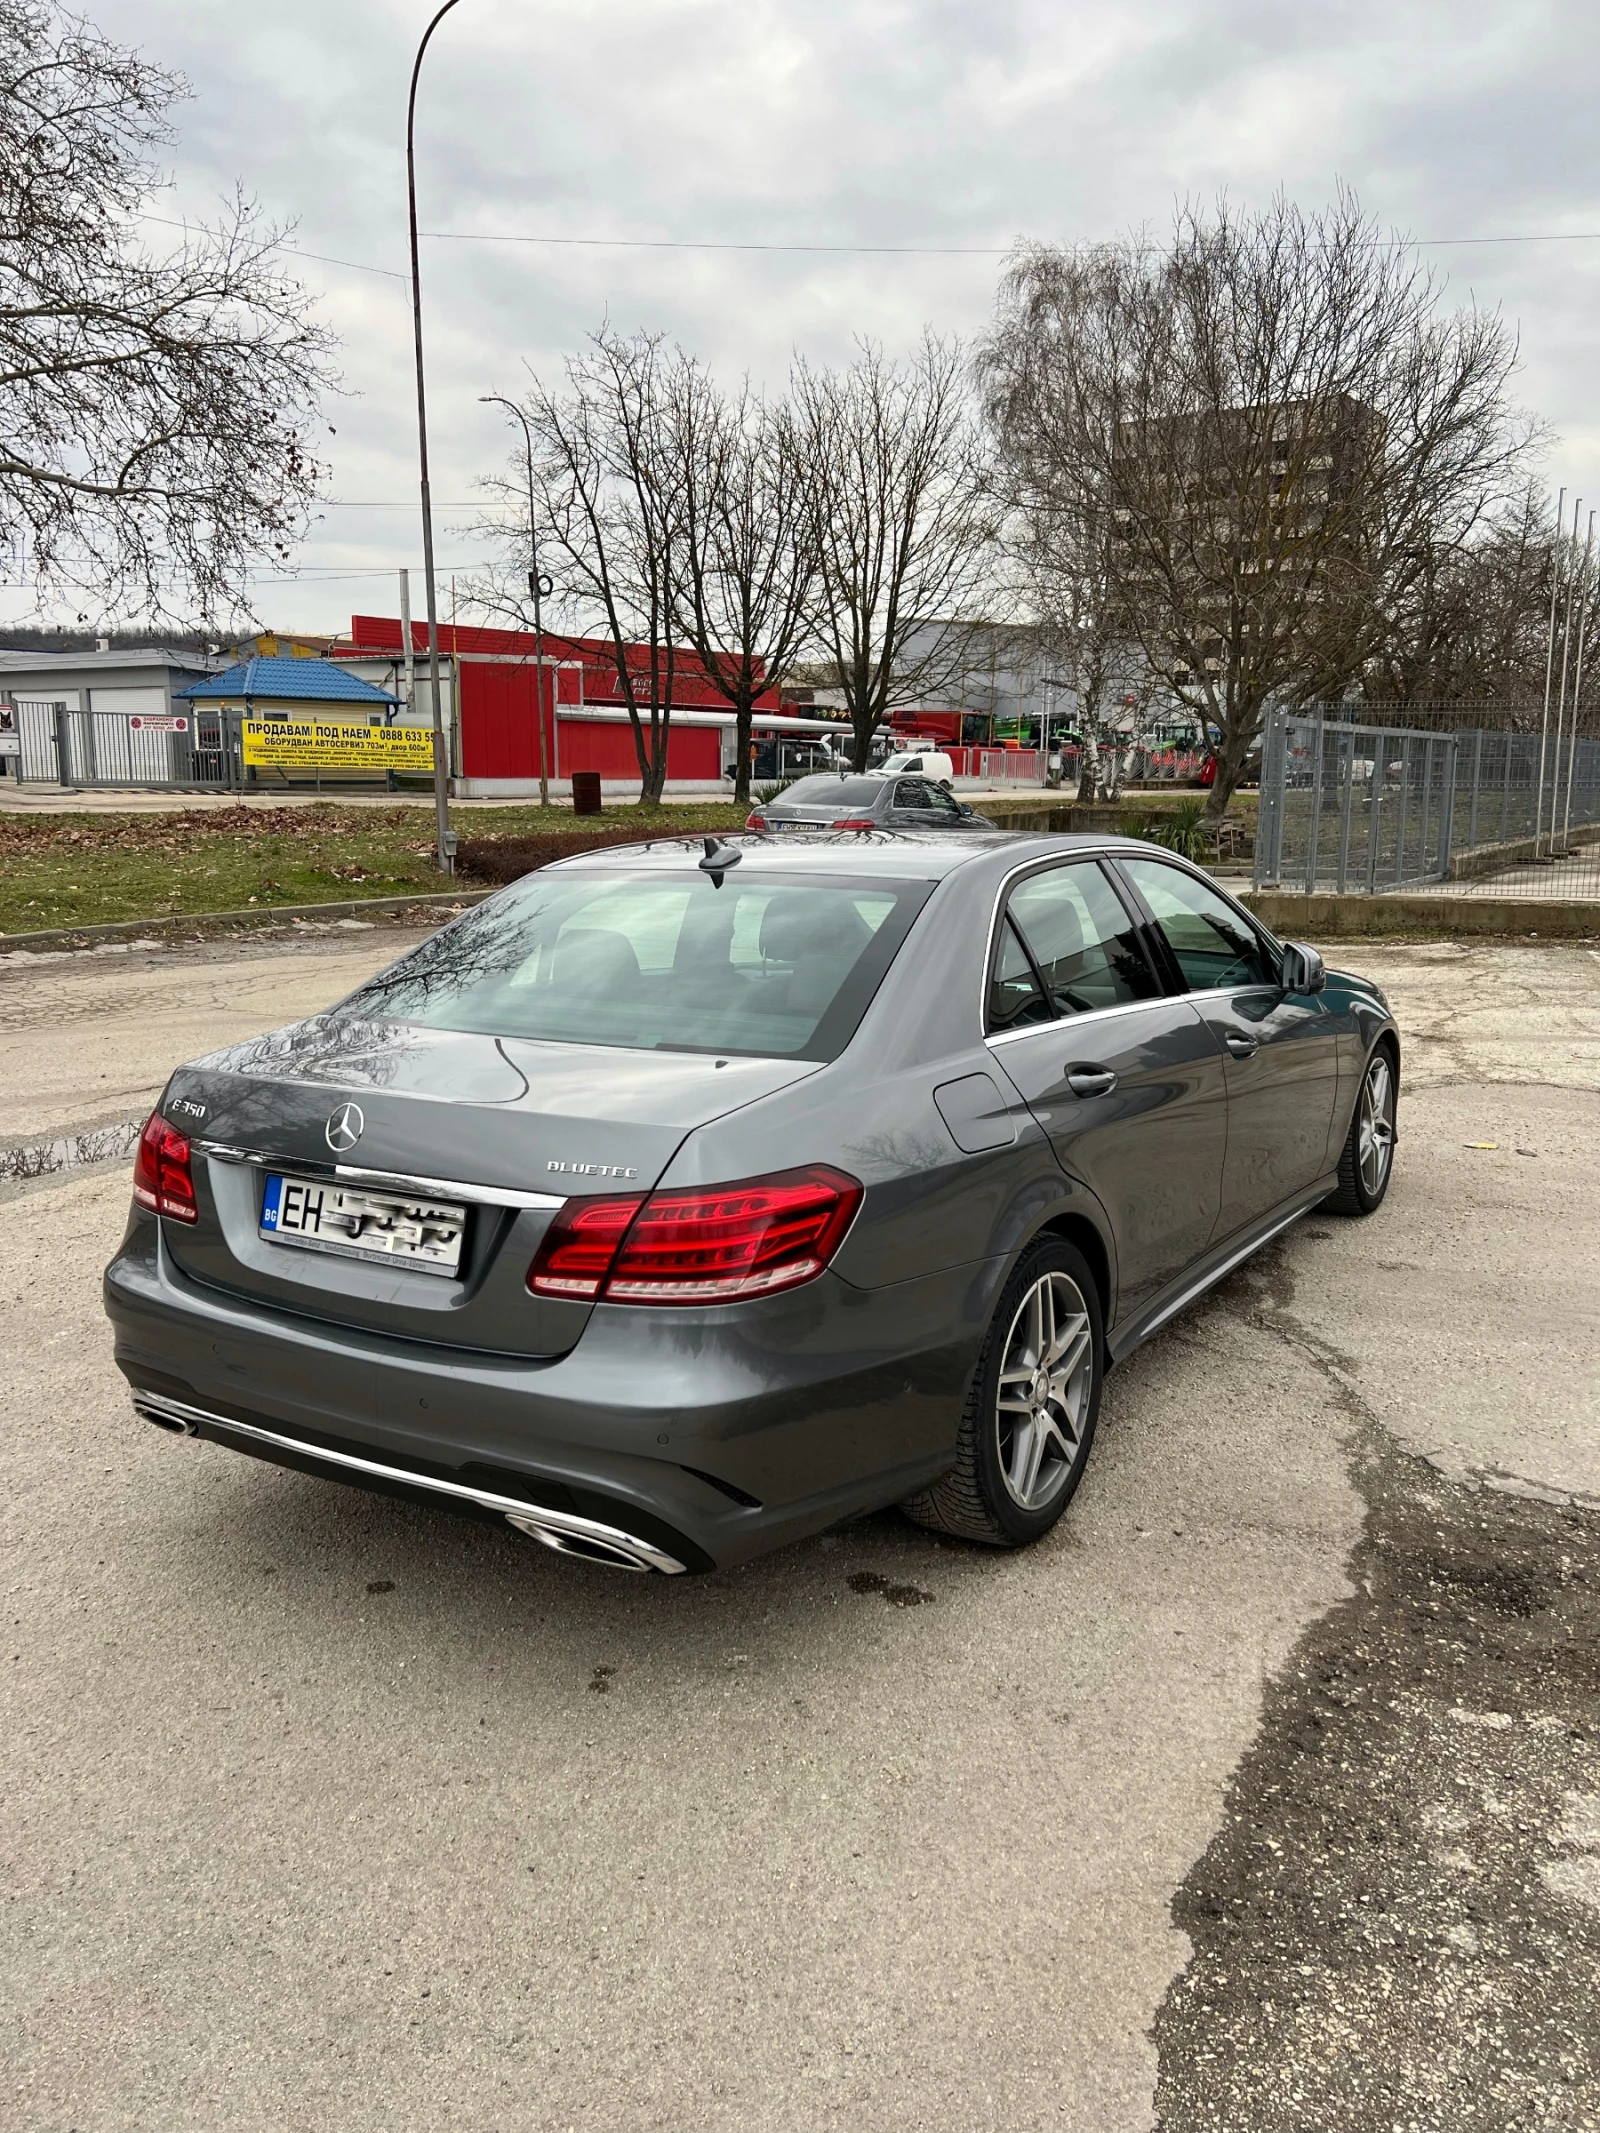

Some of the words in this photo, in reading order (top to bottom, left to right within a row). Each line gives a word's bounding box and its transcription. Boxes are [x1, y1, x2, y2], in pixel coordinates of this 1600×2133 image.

[265, 737, 313, 747] ОБОРУДВАН
[315, 739, 364, 748] АВТОСЕРВИЗ
[316, 726, 339, 739] ПОД
[342, 727, 371, 739] НАЕМ
[380, 730, 403, 740] 0888
[405, 731, 422, 742] 633
[172, 1098, 182, 1111] E
[180, 1101, 206, 1118] 350
[547, 1161, 638, 1179] BLUETEC
[264, 1208, 277, 1223] BG
[284, 1235, 321, 1249] Mercedes-Benz
[324, 1243, 360, 1258] Niederlassung
